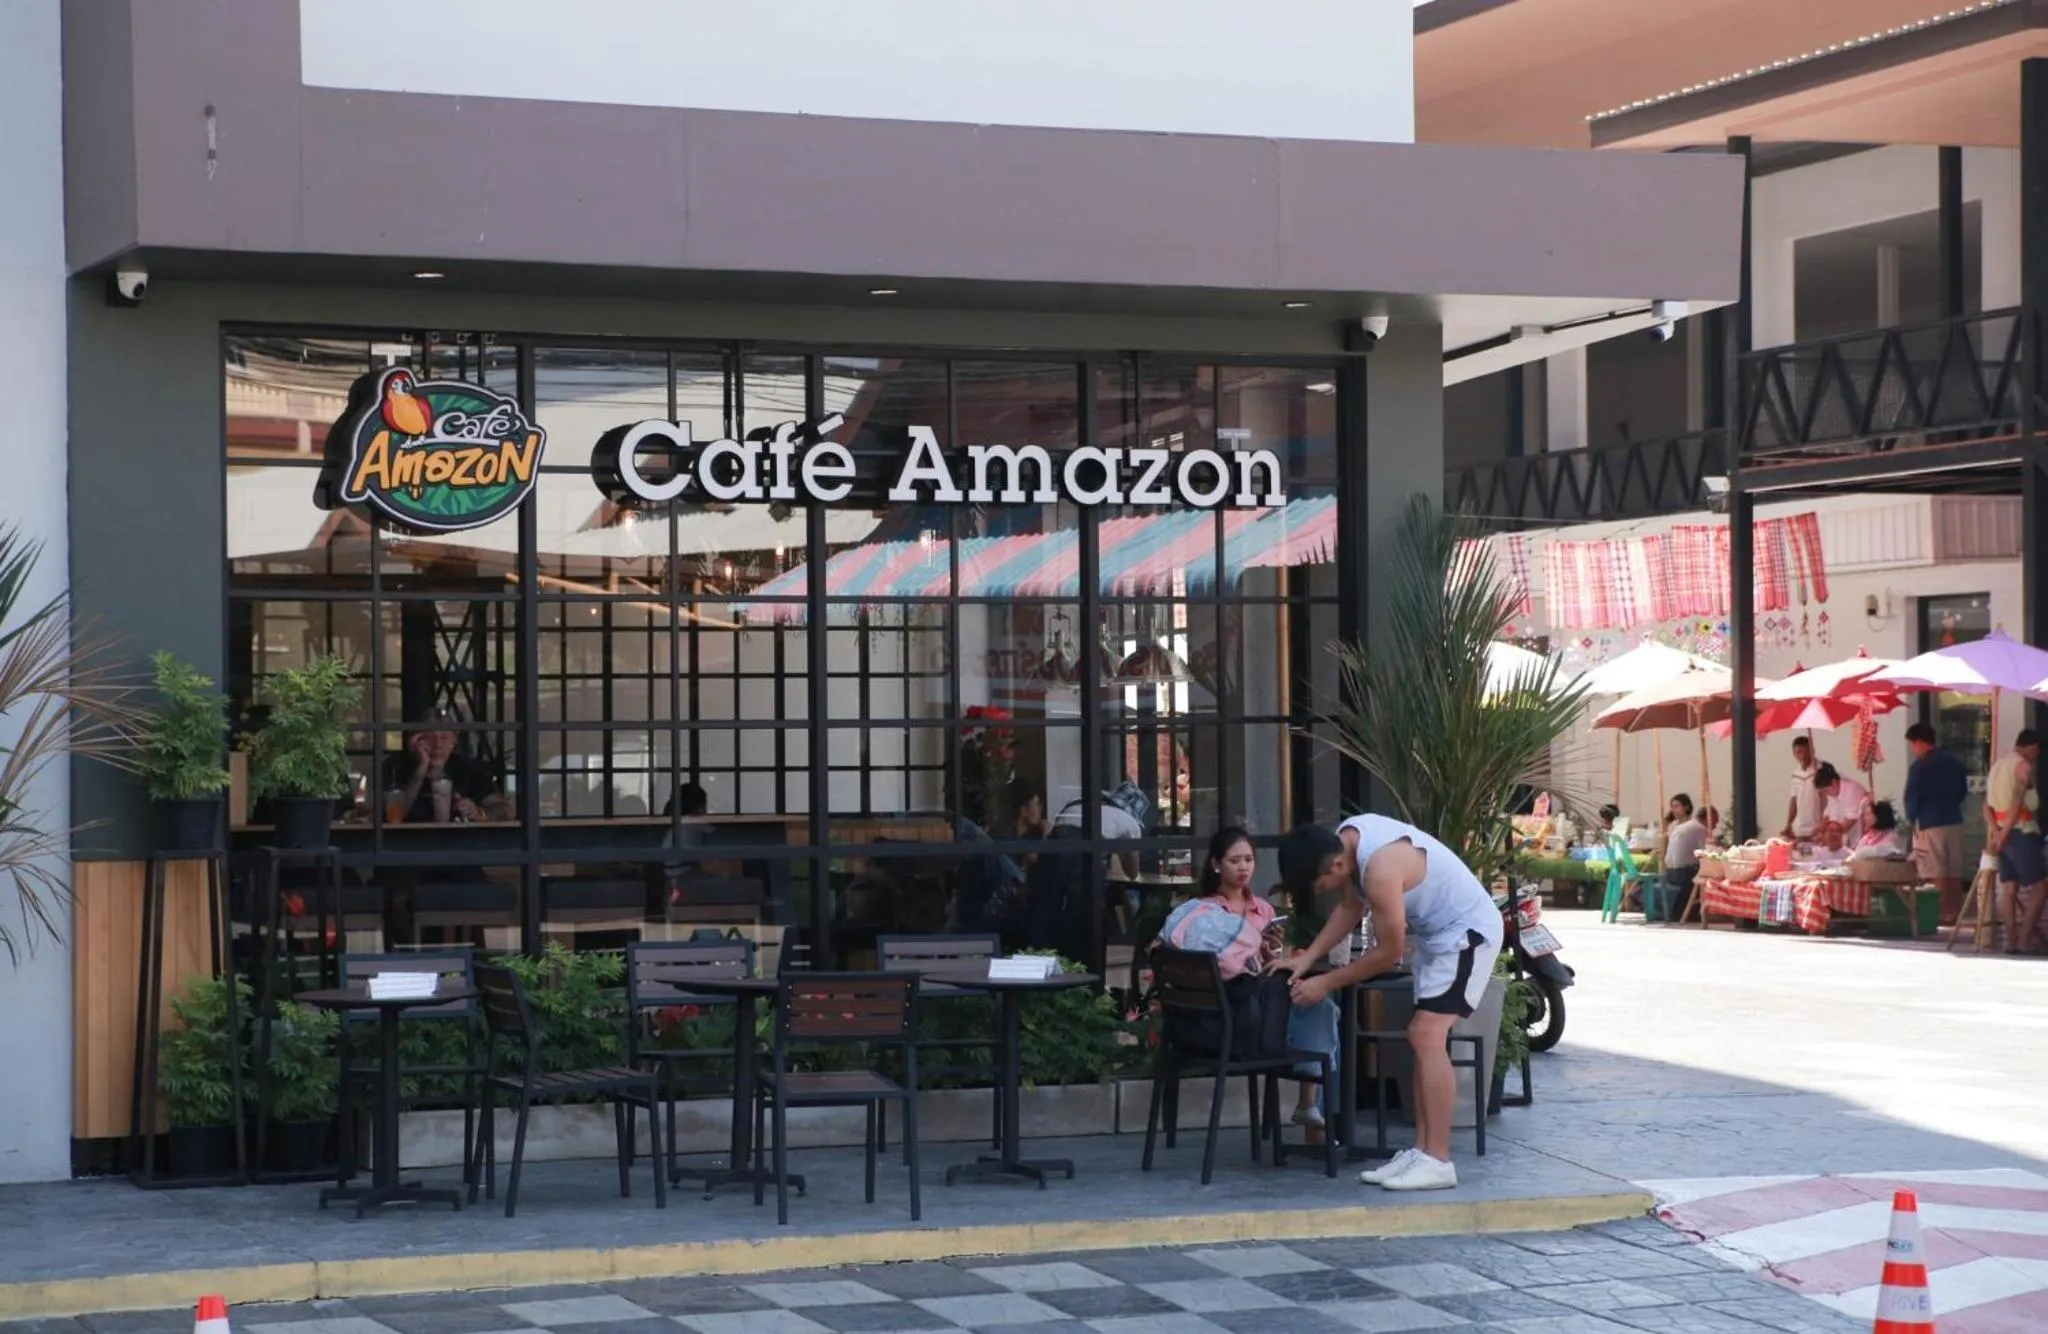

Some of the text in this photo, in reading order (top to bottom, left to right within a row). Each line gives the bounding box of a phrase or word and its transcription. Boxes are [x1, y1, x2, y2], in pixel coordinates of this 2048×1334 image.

[433, 404, 520, 440] Café
[619, 413, 1287, 507] Café Amazon
